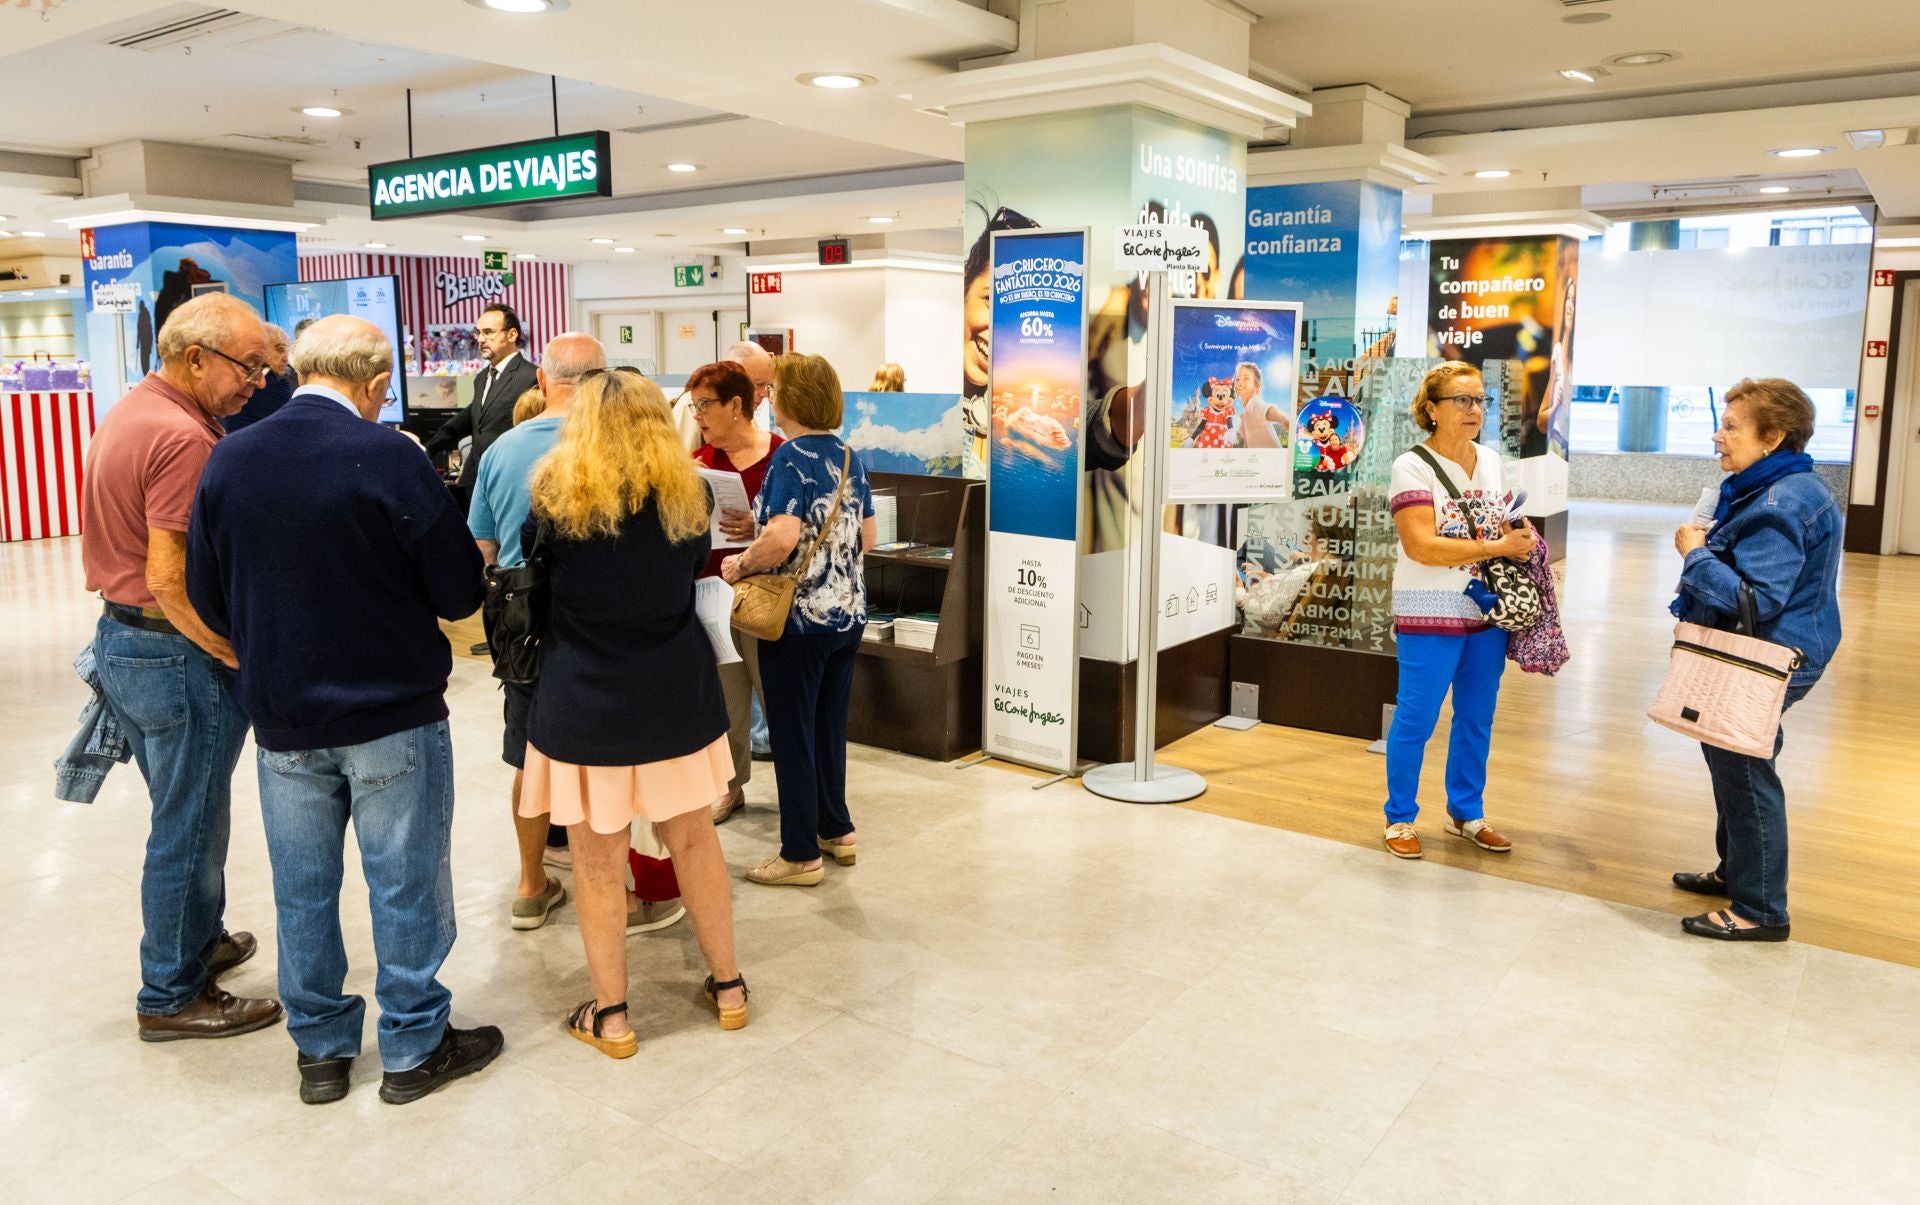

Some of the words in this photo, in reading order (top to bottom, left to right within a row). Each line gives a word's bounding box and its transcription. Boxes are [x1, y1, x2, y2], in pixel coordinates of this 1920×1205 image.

[375, 167, 475, 206] AGENCIA
[479, 161, 513, 193] DE
[513, 149, 597, 192] VIAJES
[1140, 143, 1172, 179] Una
[1176, 154, 1237, 194] sonrisa
[1248, 204, 1332, 228] Garantía
[1123, 228, 1162, 239] VIAJES
[825, 244, 843, 263] 09
[1123, 242, 1135, 257] El
[1135, 243, 1162, 257] Corte
[1162, 240, 1200, 261] Inglés
[1247, 234, 1342, 255] confianza
[89, 248, 133, 270] Garantía
[1012, 257, 1064, 273] CRUCERO
[1187, 263, 1200, 271] Baja
[1440, 256, 1459, 270] Tu
[436, 271, 504, 307] BELROS
[995, 272, 1052, 295] FANTÁSTICO
[1054, 274, 1080, 292] 2026
[1439, 275, 1545, 298] compañero
[1438, 304, 1457, 320] de
[1461, 301, 1509, 319] buen
[1021, 317, 1053, 337] 60%
[1438, 326, 1483, 348] viaje
[1021, 559, 1042, 568] HASTA
[1017, 568, 1047, 589] 10%
[1007, 586, 1016, 594] DE
[1017, 588, 1054, 600] DESCUENTO
[1013, 597, 1047, 608] ADICIONAL
[1026, 633, 1034, 645] 6
[1016, 651, 1034, 660] PAGO
[1035, 654, 1043, 662] EN
[994, 683, 1029, 698] VIAJES
[994, 697, 1004, 712] El
[1004, 699, 1028, 718] Corte
[1028, 702, 1064, 726] Inglés
